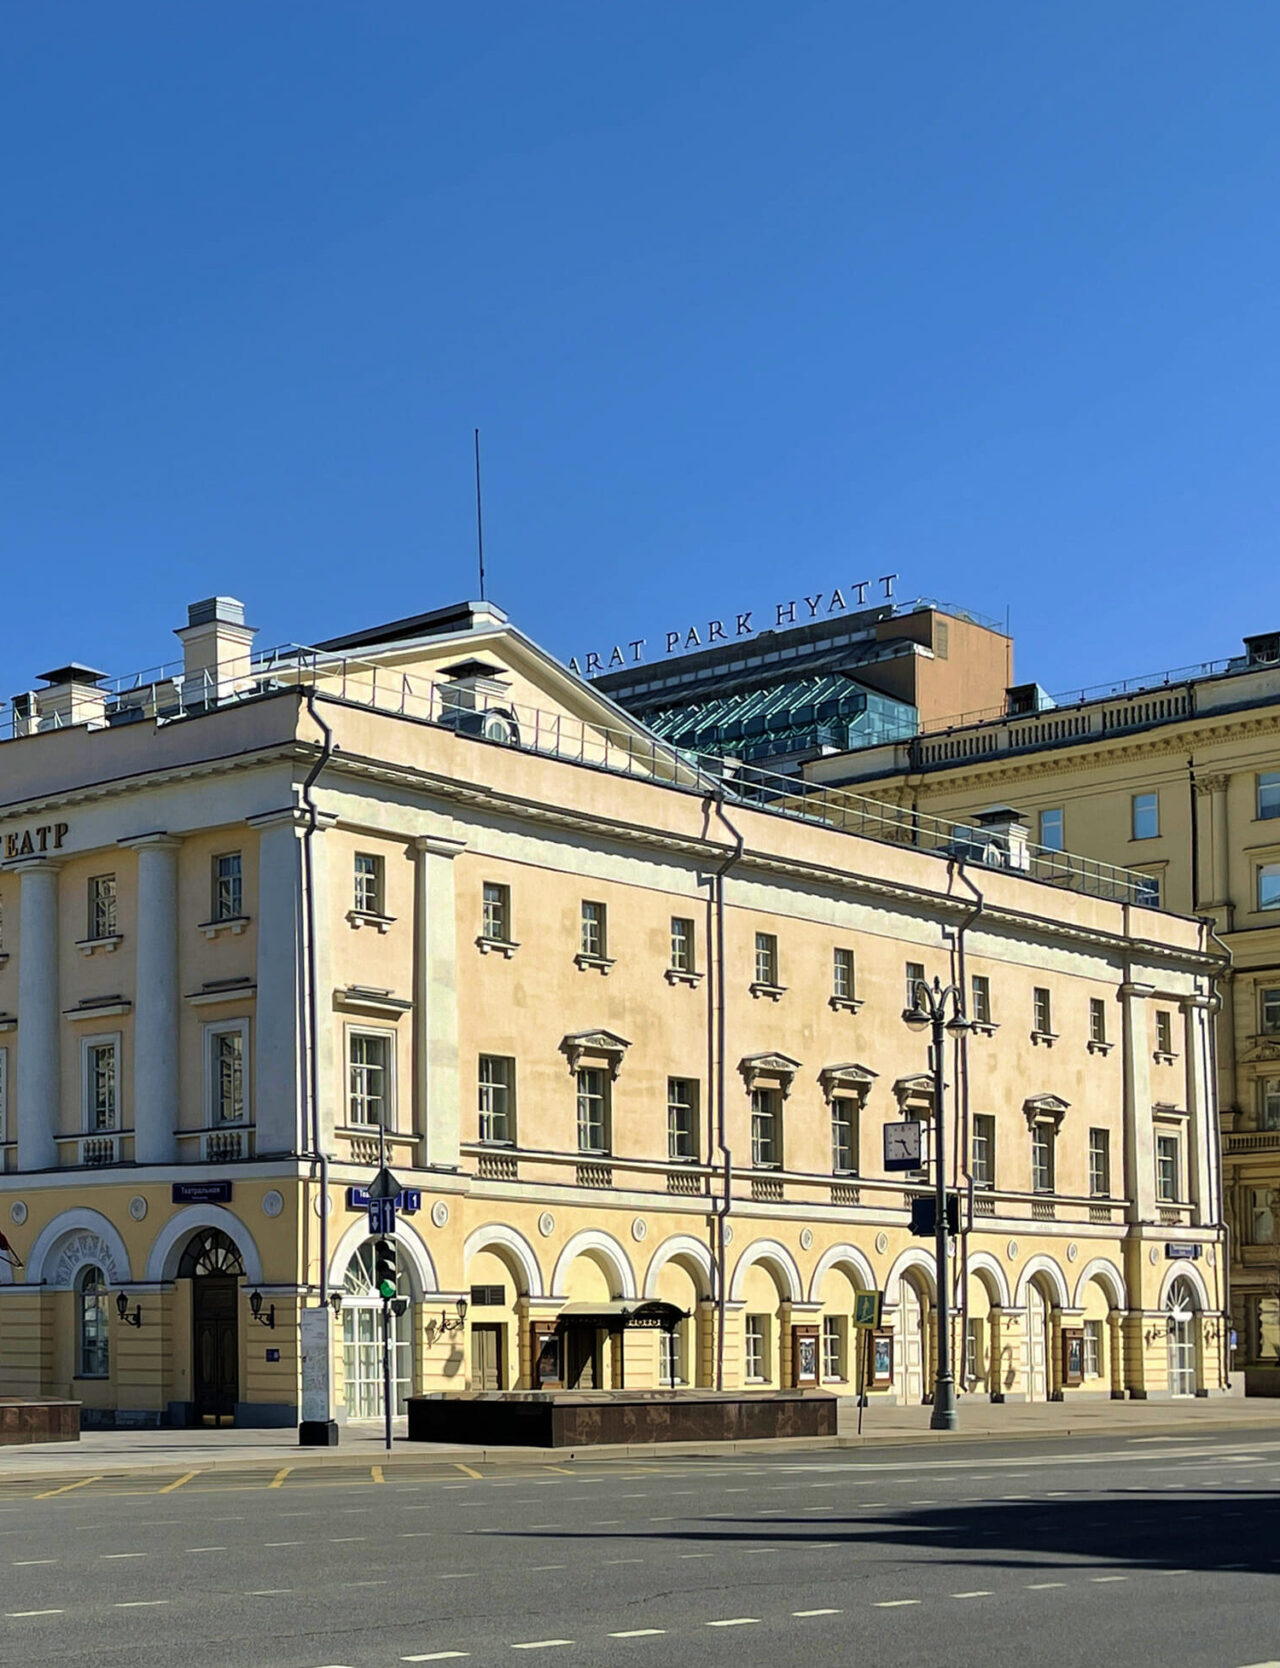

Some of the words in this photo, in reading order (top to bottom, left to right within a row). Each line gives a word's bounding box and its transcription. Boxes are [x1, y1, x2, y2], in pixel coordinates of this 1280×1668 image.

[666, 611, 754, 653] PARK
[776, 574, 900, 626] HYATT
[412, 1194, 418, 1208] 1
